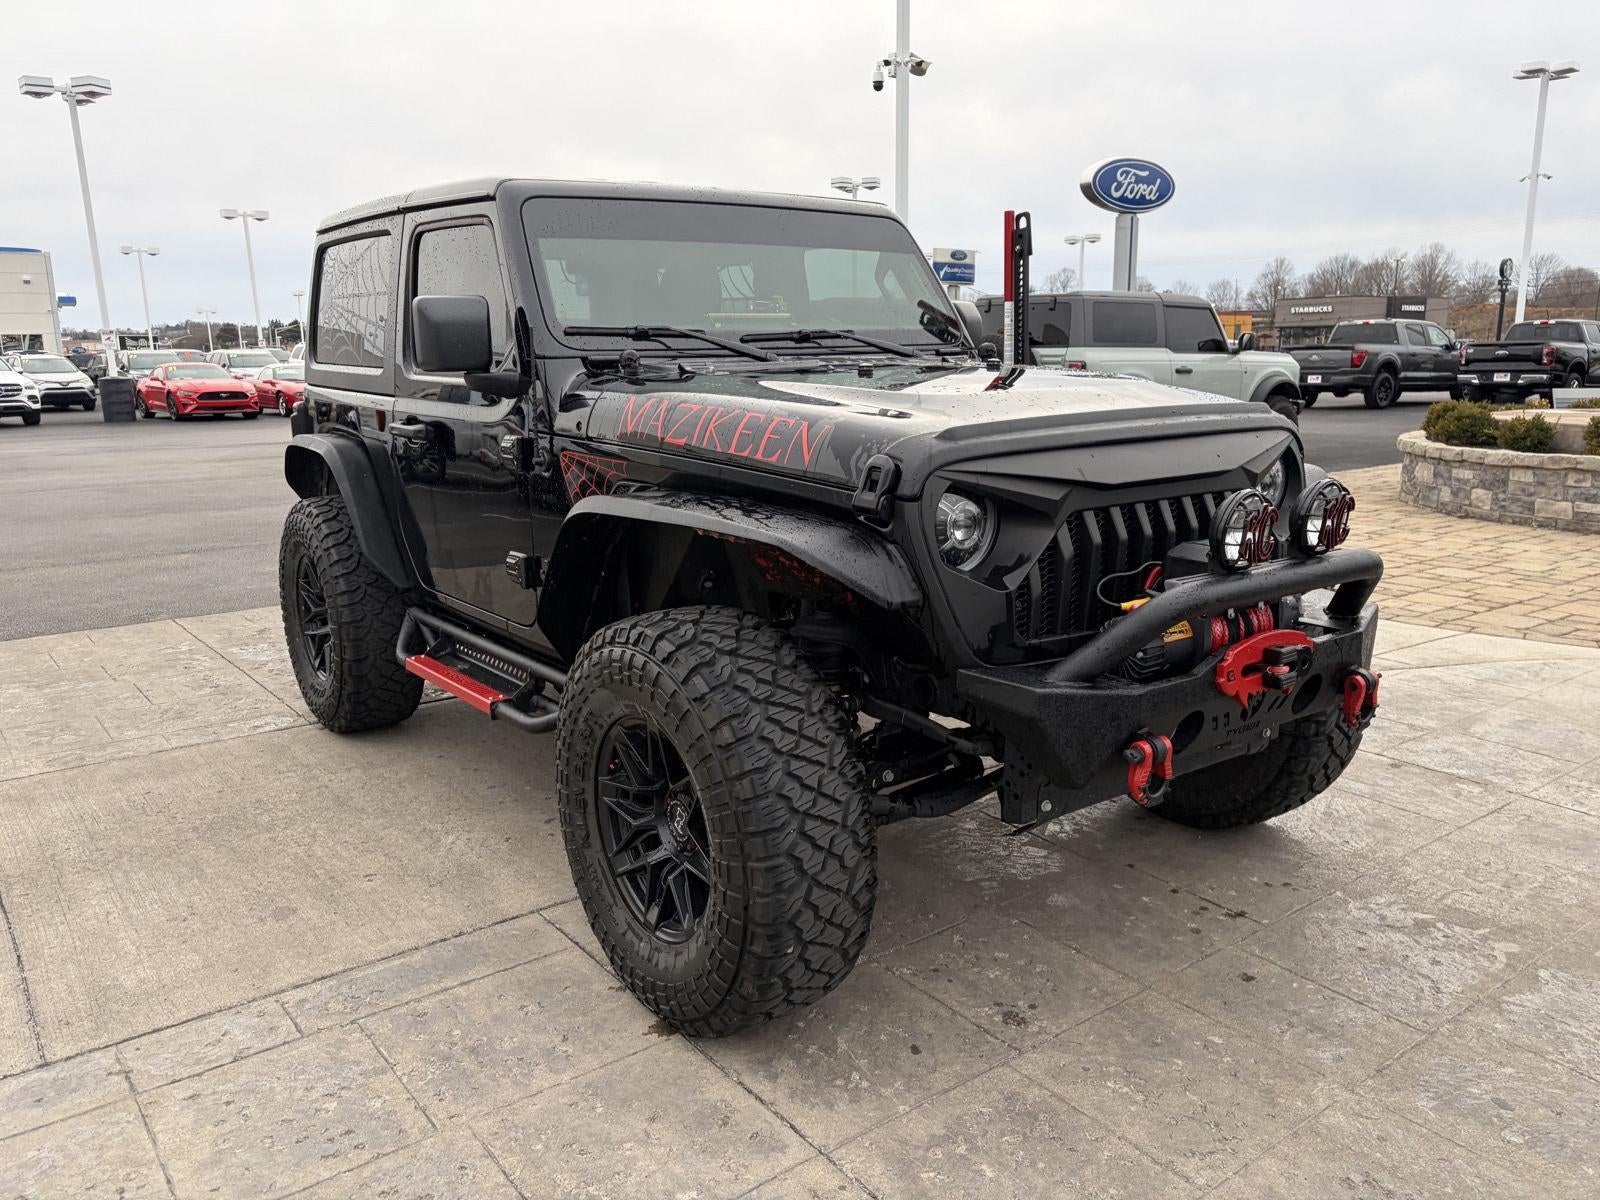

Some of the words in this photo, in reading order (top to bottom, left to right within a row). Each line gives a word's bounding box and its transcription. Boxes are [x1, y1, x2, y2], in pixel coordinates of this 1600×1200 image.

[1110, 166, 1161, 201] Ford
[1290, 305, 1333, 314] STARBUCKS
[1401, 304, 1426, 312] STARBUCKS
[615, 395, 834, 467] MAZIKEEN
[1239, 502, 1280, 566] KC
[1319, 492, 1356, 550] KC
